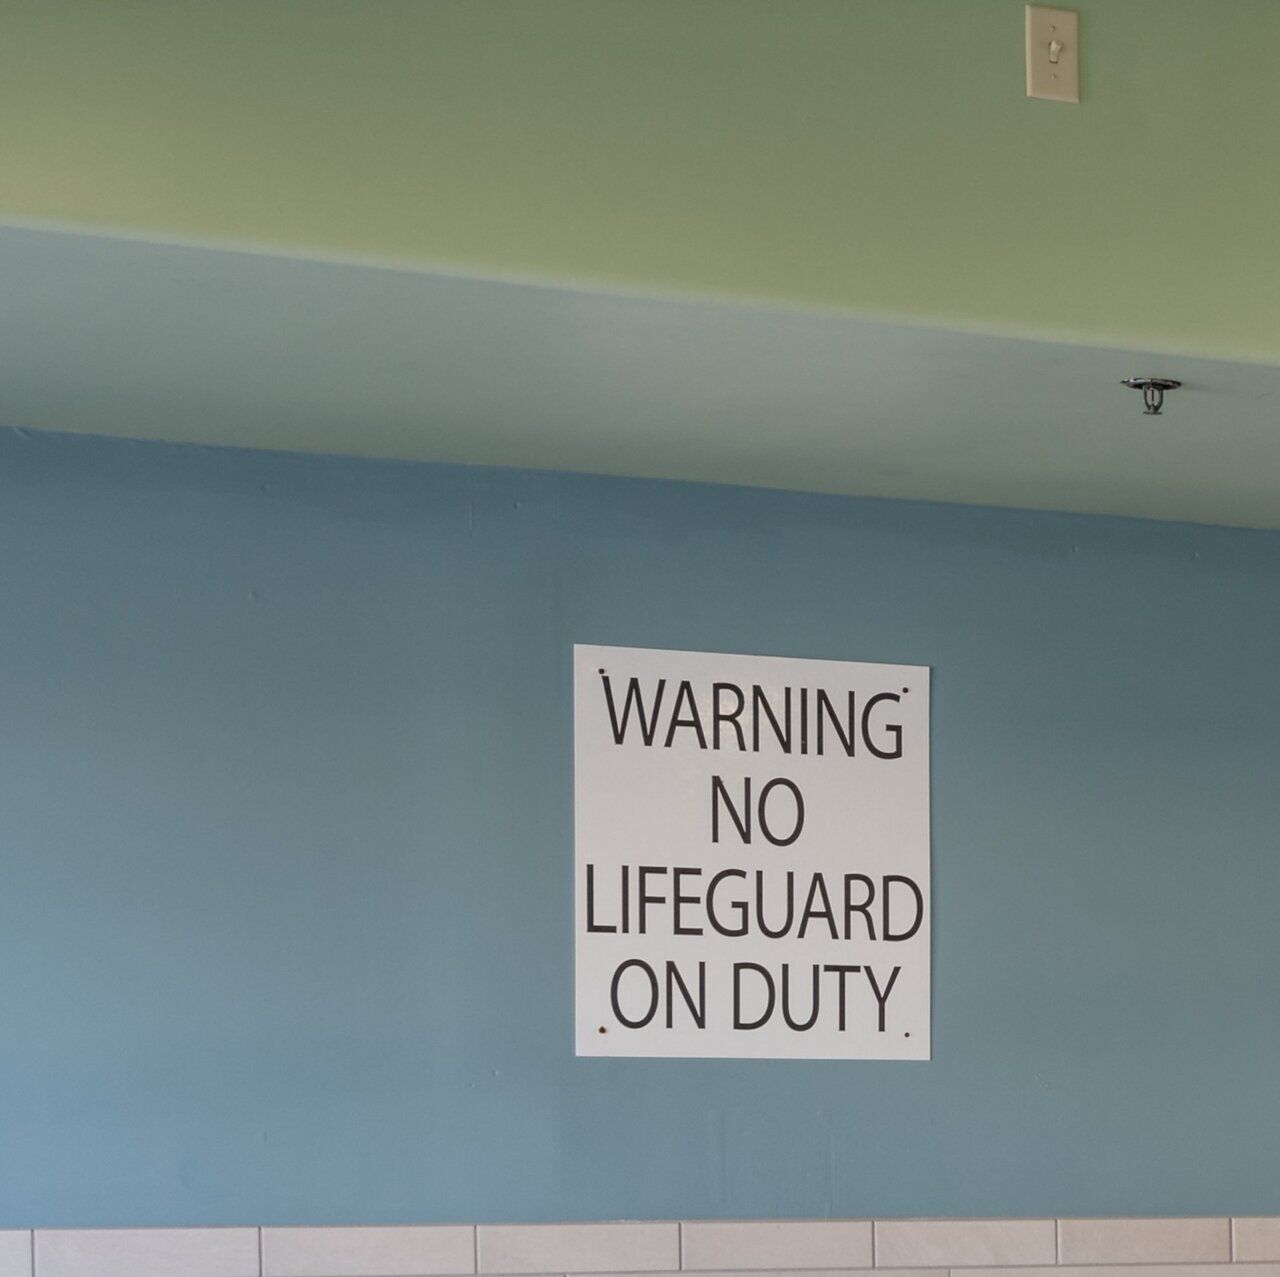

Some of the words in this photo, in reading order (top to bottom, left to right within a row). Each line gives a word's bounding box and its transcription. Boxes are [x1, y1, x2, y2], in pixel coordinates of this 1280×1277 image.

[602, 675, 903, 760] WARNING
[712, 775, 805, 847] NO
[586, 863, 924, 942] LIFEGUARD
[610, 958, 707, 1030] ON
[732, 961, 902, 1033] DUTY
